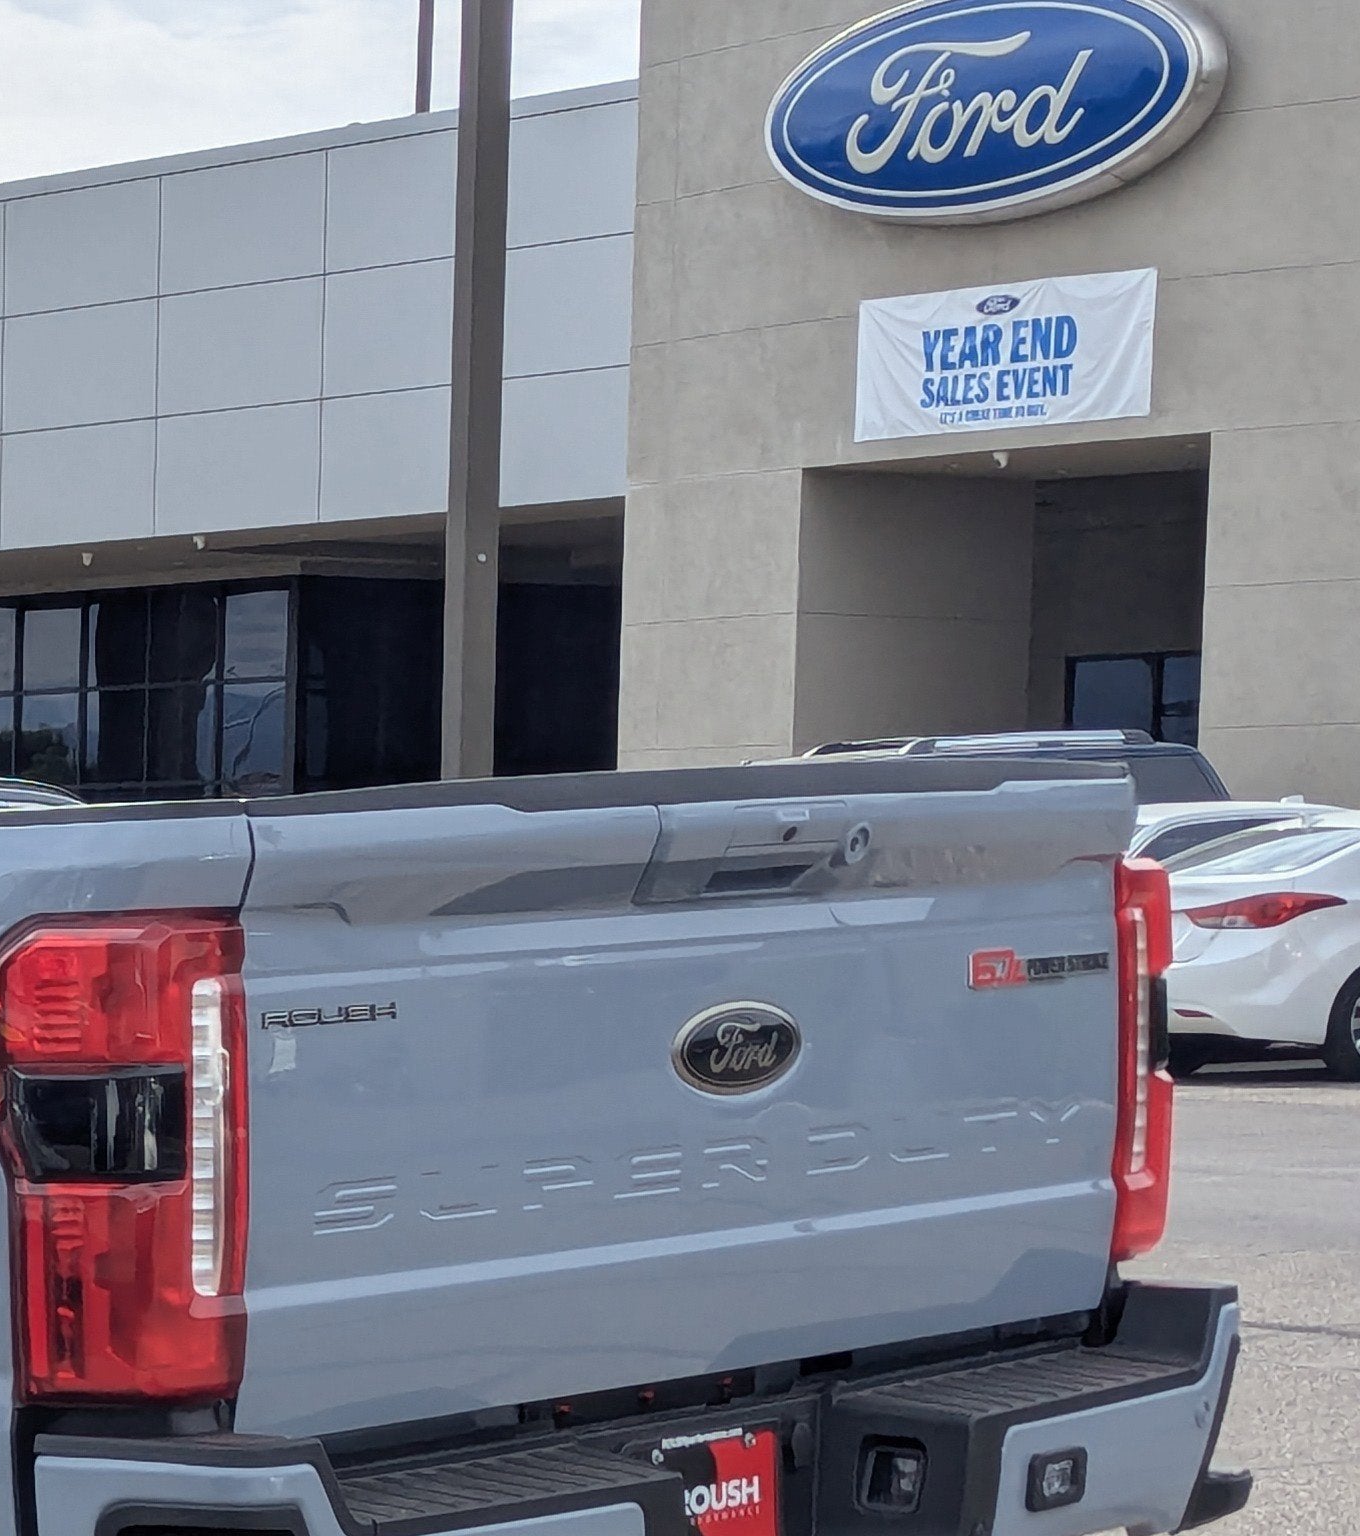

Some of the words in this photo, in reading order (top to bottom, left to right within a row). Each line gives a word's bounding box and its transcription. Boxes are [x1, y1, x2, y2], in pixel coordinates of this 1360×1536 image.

[846, 31, 1093, 174] Ford
[922, 324, 1003, 372] YEAR
[1010, 315, 1077, 363] END
[920, 371, 990, 409] SALES
[996, 363, 1073, 402] EVENT
[261, 1002, 397, 1029] ROUSH
[710, 1022, 778, 1073] Ford
[313, 1135, 766, 1234] SUPER
[807, 1102, 1080, 1174] DUTY
